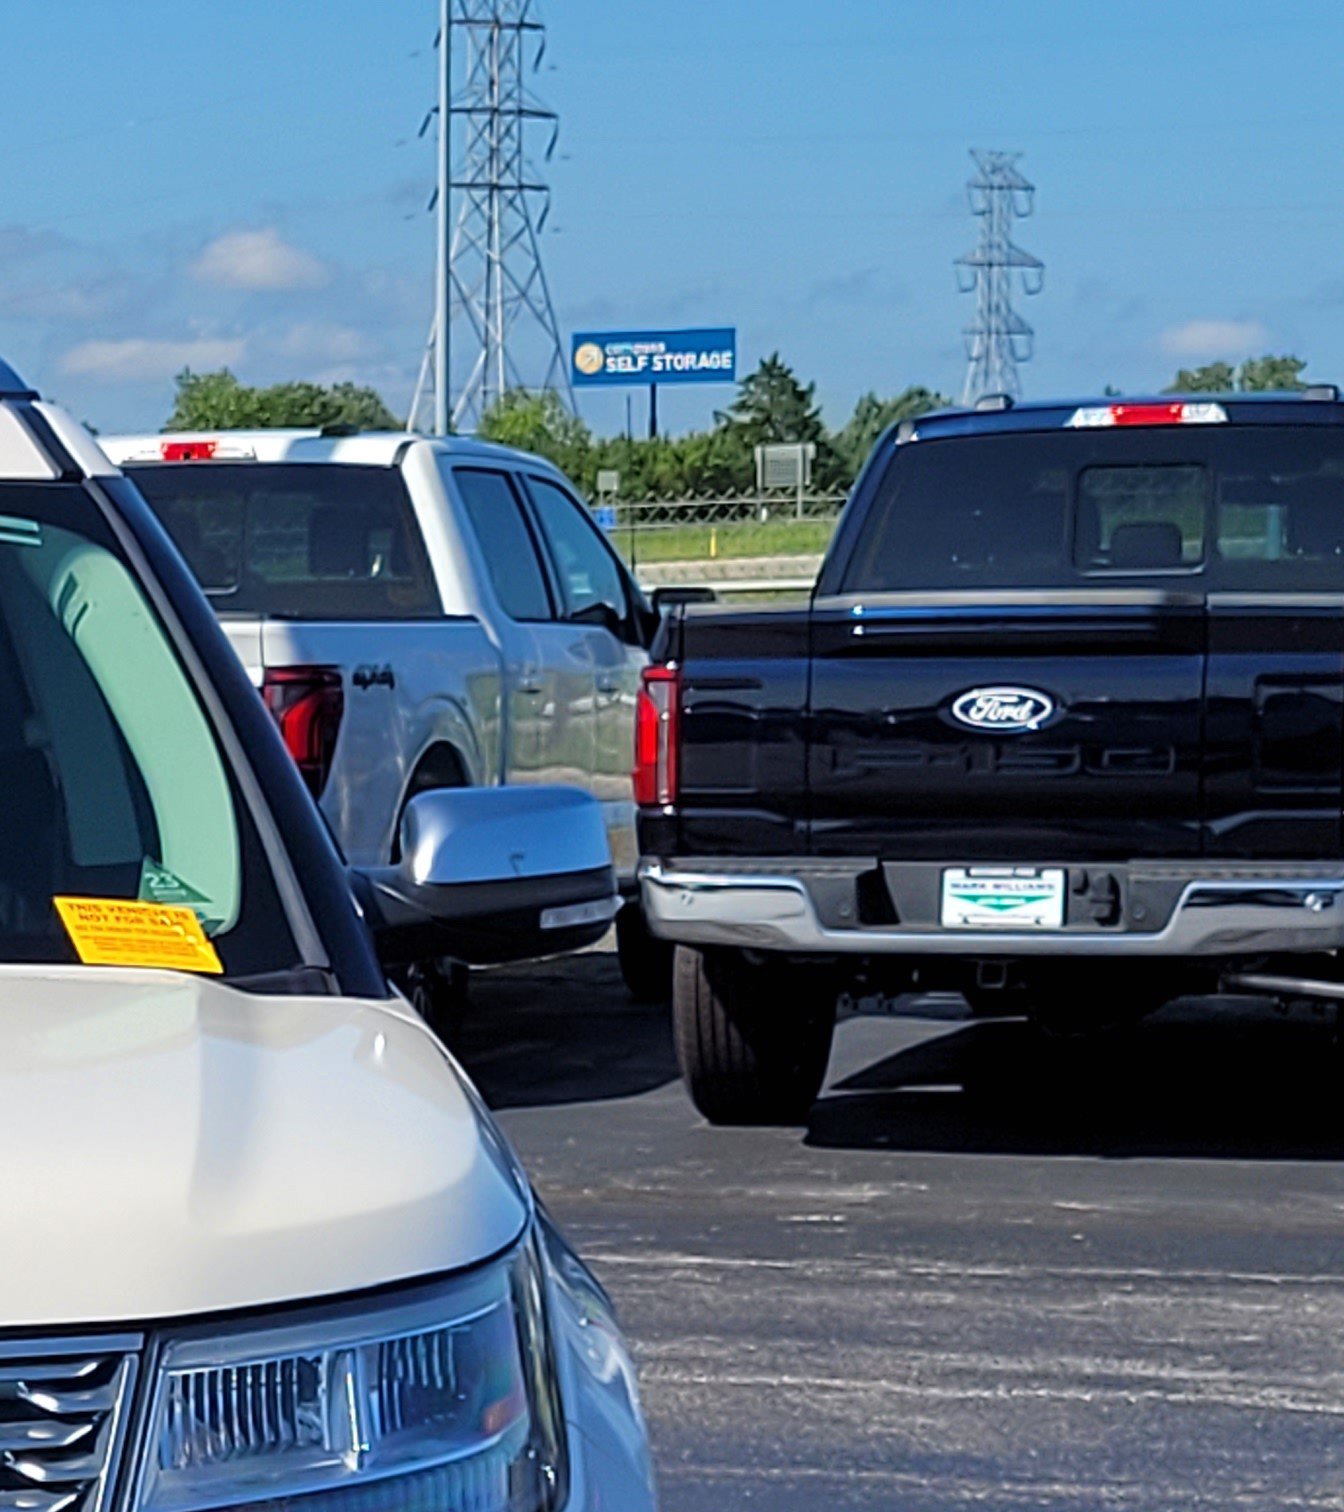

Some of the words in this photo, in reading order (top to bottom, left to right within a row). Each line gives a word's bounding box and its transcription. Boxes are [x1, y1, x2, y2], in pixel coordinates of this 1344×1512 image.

[605, 356, 648, 373] SELF
[652, 350, 734, 372] STORAGE
[967, 692, 1034, 723] Ford
[68, 903, 102, 913] THIS
[108, 905, 168, 917] VEHICLE
[78, 913, 109, 923] NOT
[115, 915, 145, 925] FOR
